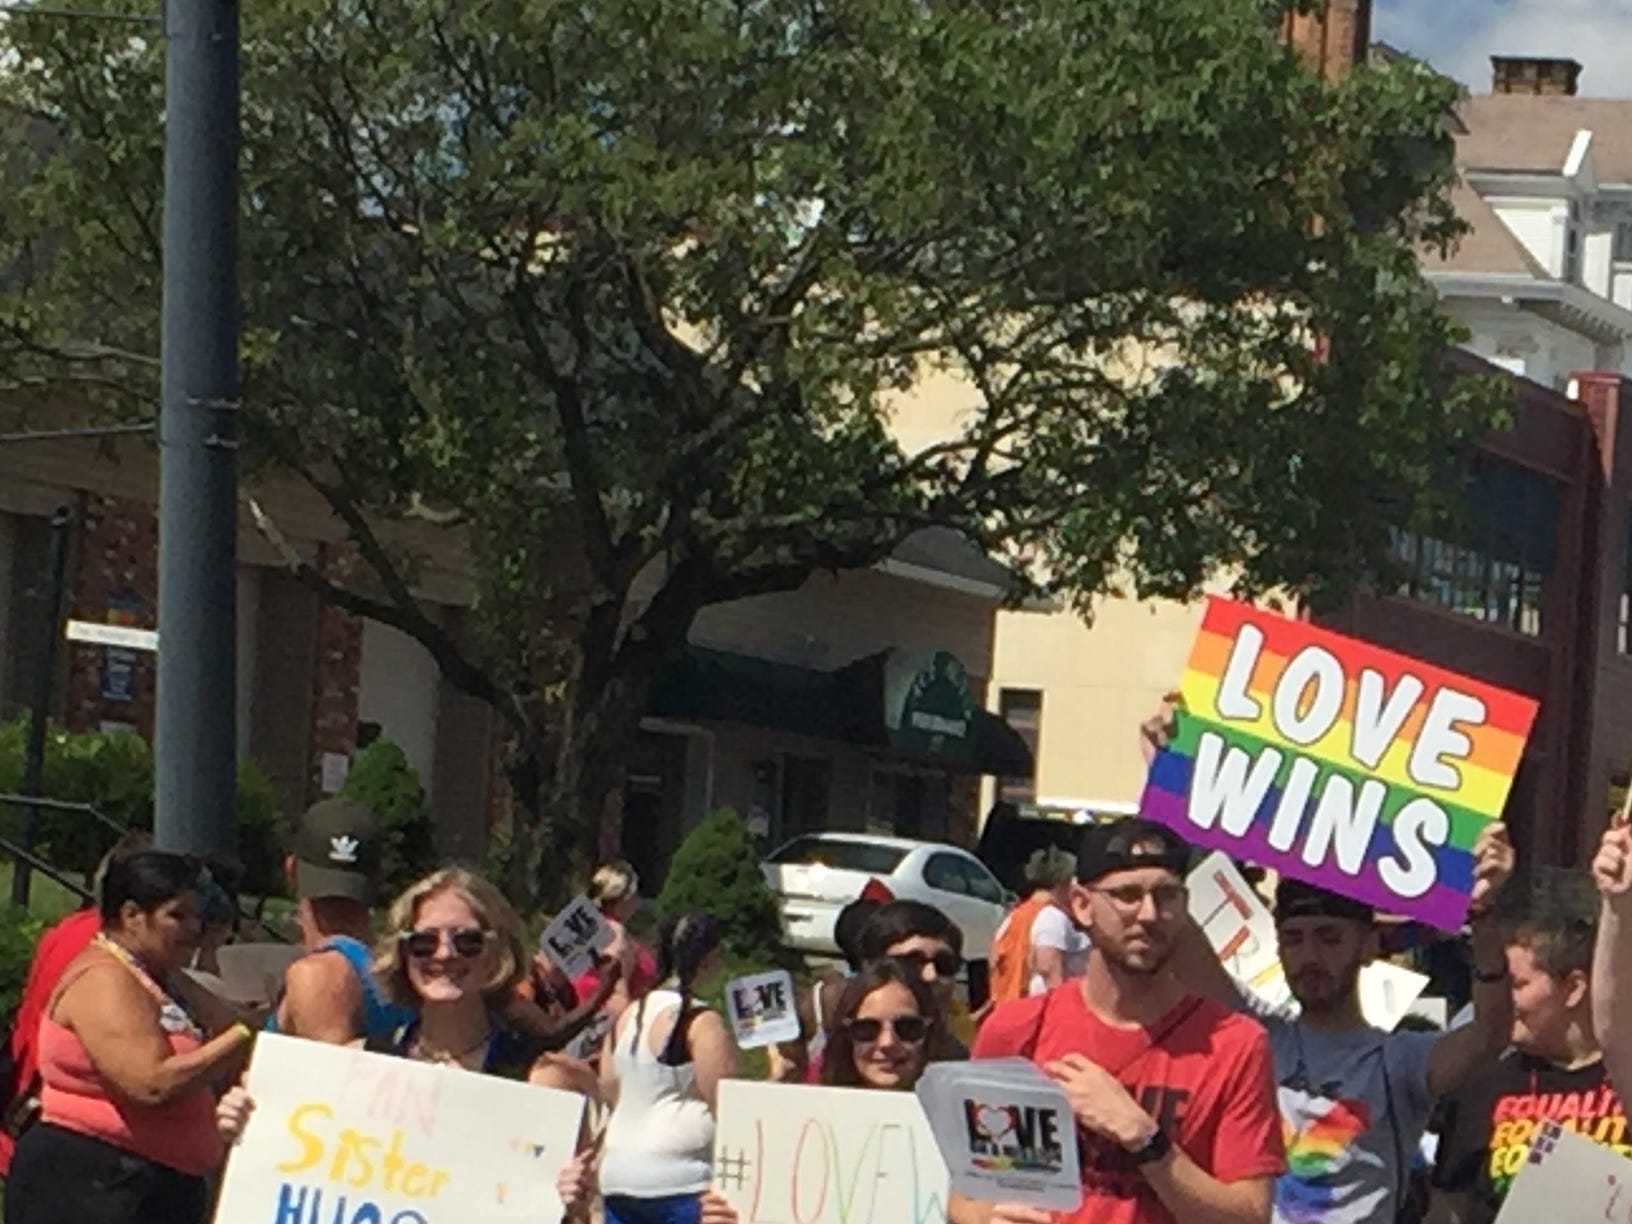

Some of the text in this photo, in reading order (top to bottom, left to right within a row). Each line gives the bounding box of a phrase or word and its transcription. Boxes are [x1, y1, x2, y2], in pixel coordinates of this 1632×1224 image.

[1216, 623, 1487, 790] LOVE
[1188, 732, 1450, 897] WINS
[275, 1103, 450, 1198] Sister
